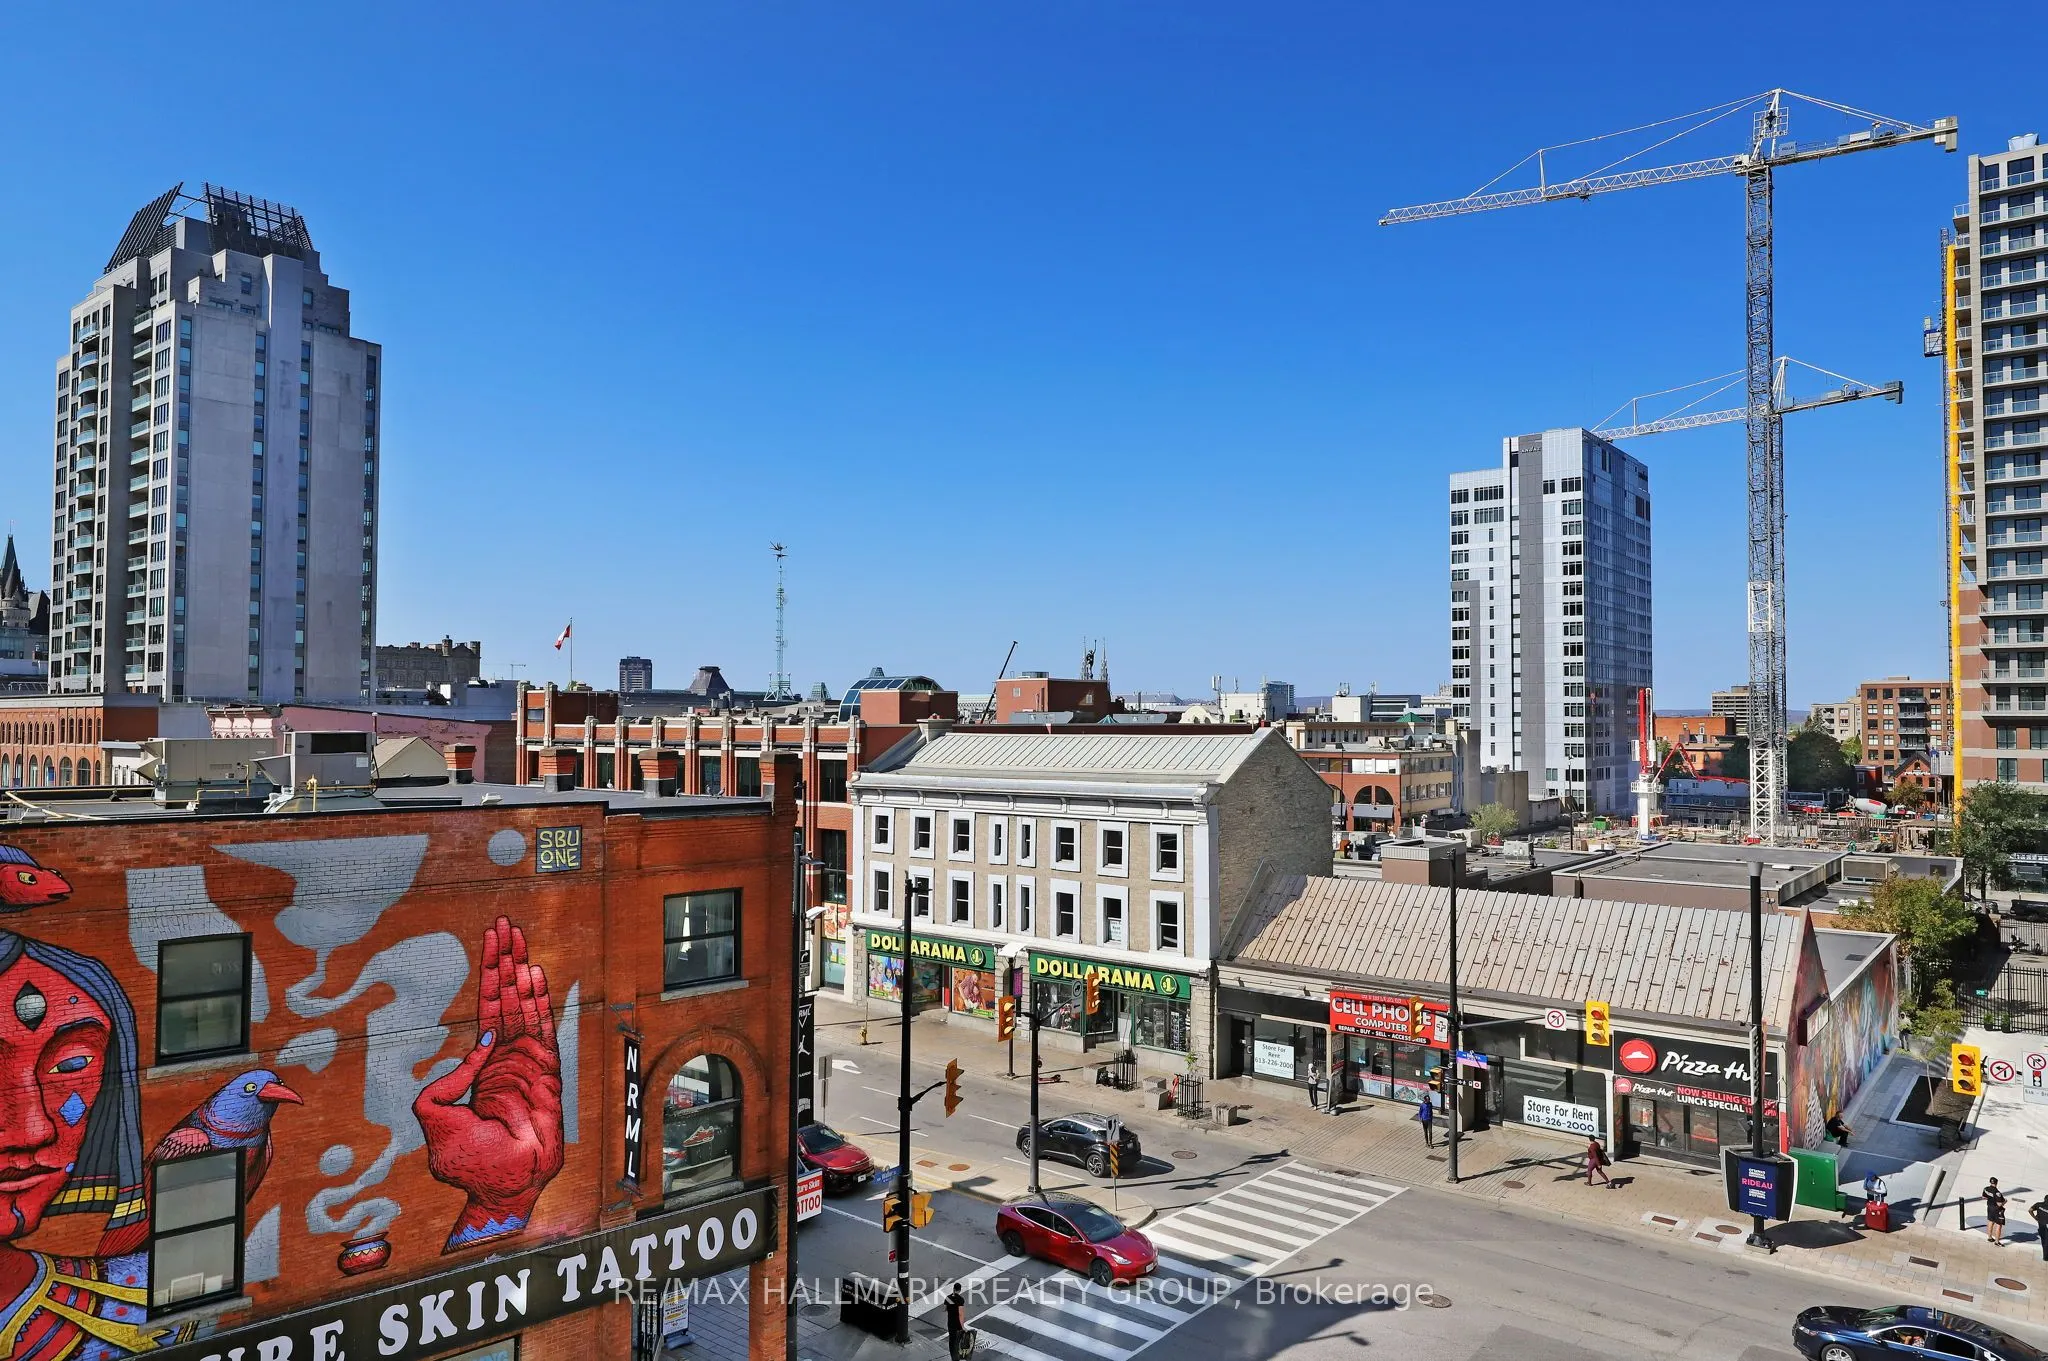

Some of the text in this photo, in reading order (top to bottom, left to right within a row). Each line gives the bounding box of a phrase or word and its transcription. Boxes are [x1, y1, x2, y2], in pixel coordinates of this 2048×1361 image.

[540, 829, 580, 848] SBU
[540, 848, 579, 869] ONE
[1036, 957, 1156, 991] DOLLARAMA
[798, 1008, 811, 1018] RML
[1331, 997, 1368, 1017] CELL
[1338, 1025, 1356, 1033] REPAIR
[1360, 1028, 1371, 1036] BUY
[1355, 1017, 1408, 1033] COMPUTER
[1262, 1044, 1286, 1053] Store For
[1254, 1057, 1294, 1069] 613-226-2000
[1660, 1050, 1772, 1082] Pizza Hu
[1633, 1083, 1675, 1098] Pizza Hut
[1677, 1086, 1700, 1098] NOW
[1701, 1090, 1740, 1104] SELLING
[625, 1046, 641, 1178] NRML
[1527, 1100, 1594, 1122] Store For Rent
[1677, 1095, 1707, 1107] LUNCH
[1708, 1098, 1745, 1113] SPECIAL
[1526, 1113, 1595, 1133] 613-226-2000
[808, 1179, 820, 1189] Skin
[1741, 1177, 1773, 1190] RIDEAU
[797, 1194, 821, 1215] ATTOO
[377, 1268, 531, 1356] SKIN
[556, 1207, 758, 1302] TATTOO
